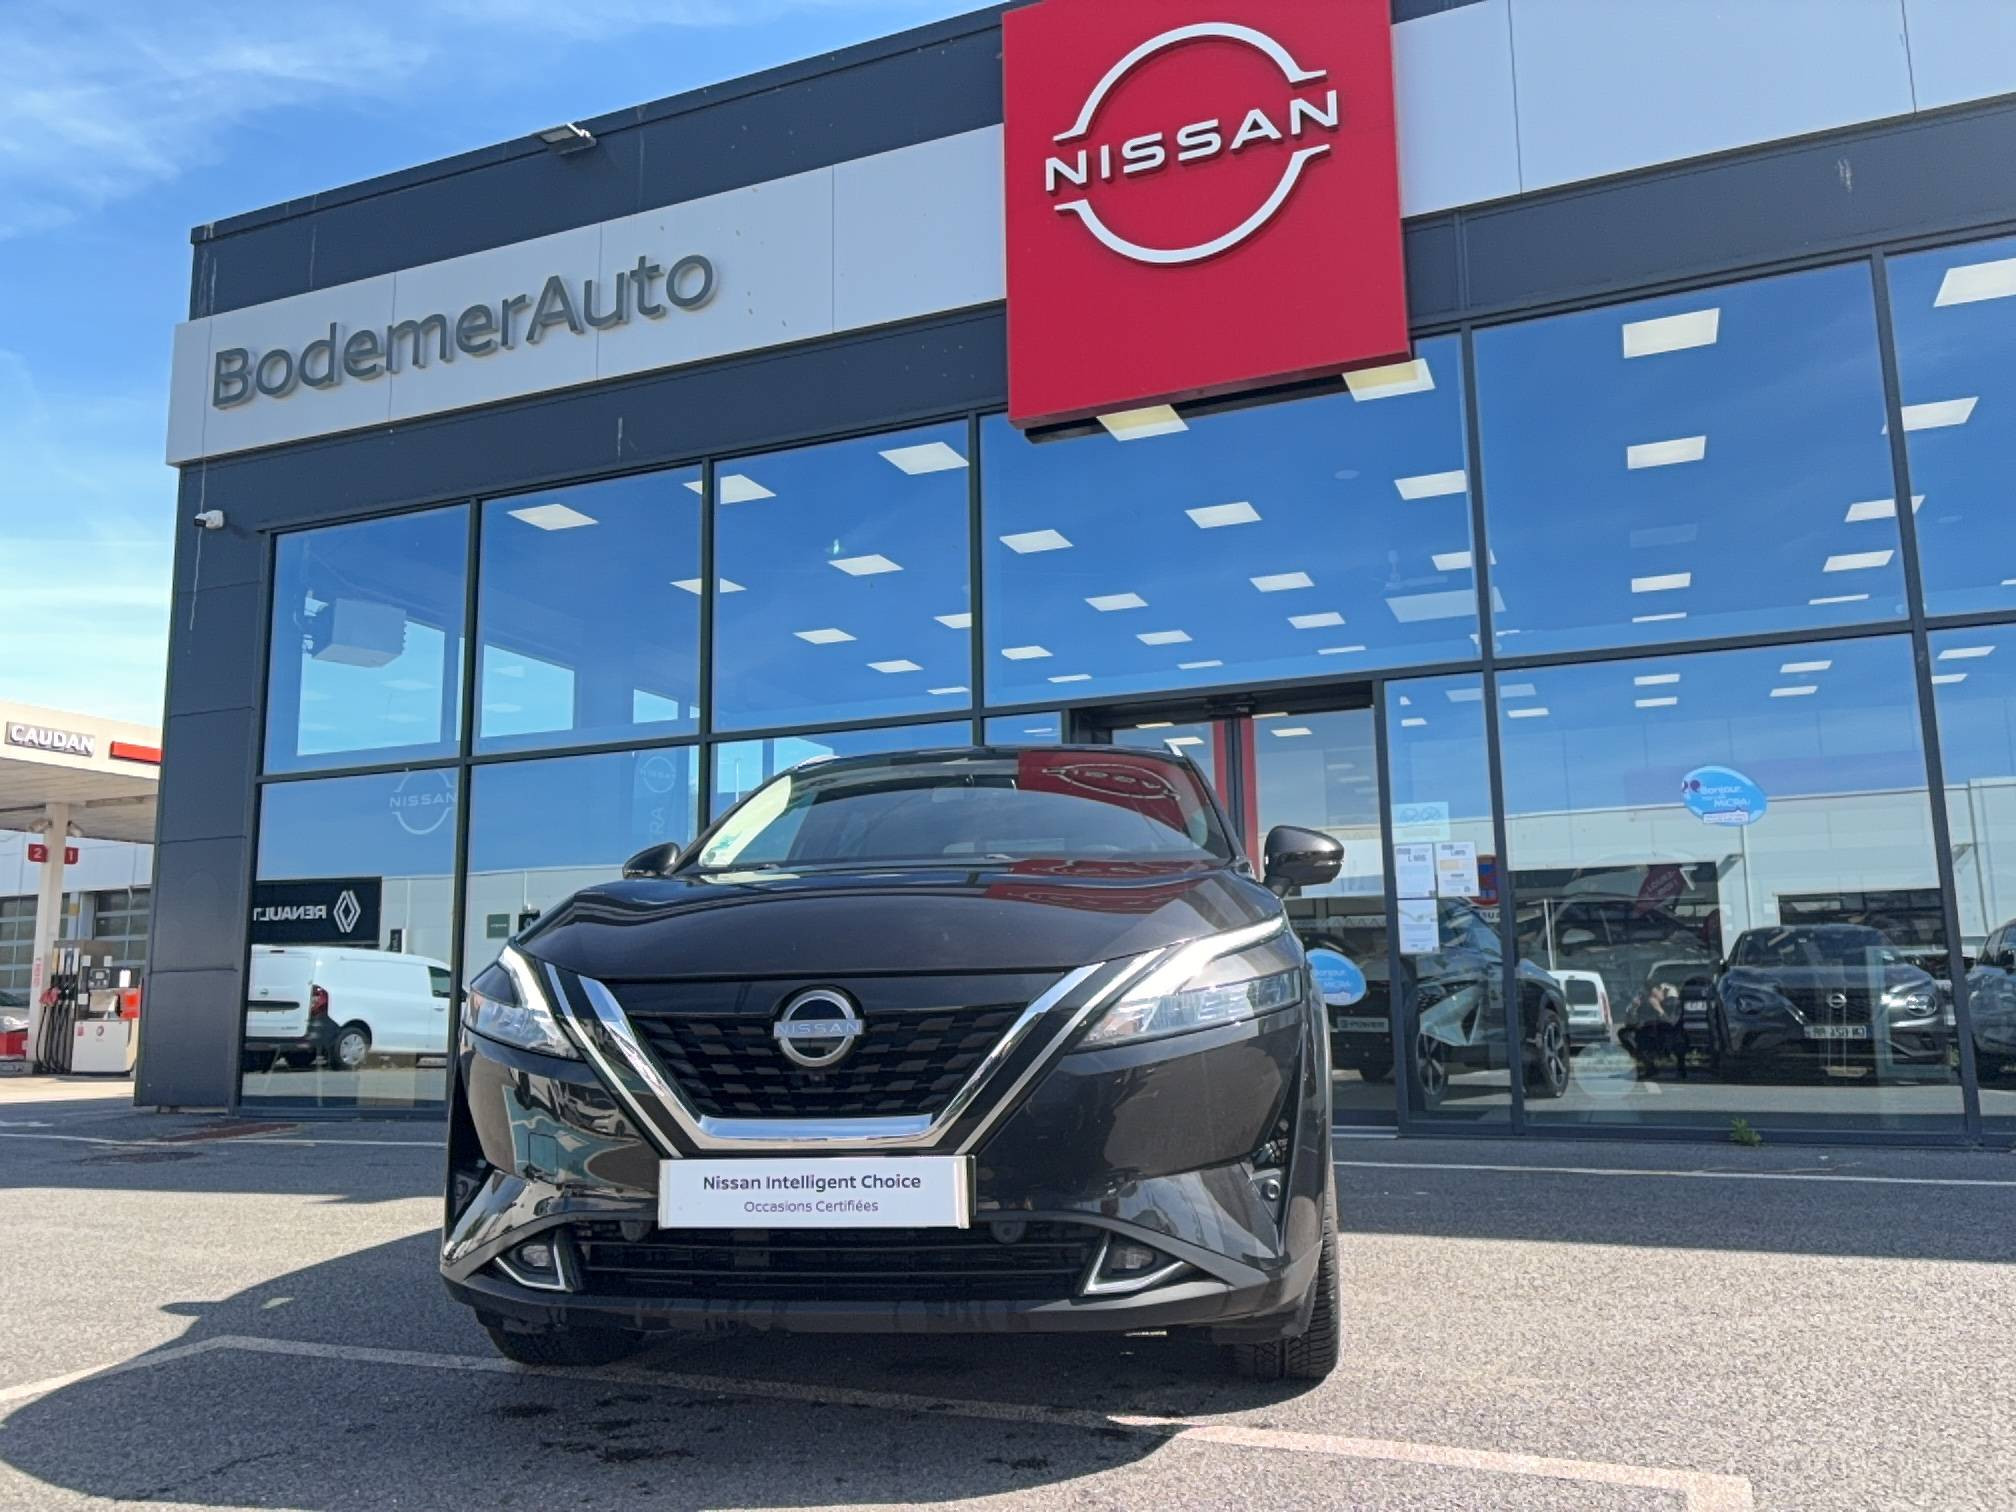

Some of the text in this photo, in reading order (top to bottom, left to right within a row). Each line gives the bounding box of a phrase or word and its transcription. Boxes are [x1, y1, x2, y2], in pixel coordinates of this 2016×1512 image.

[1045, 89, 1338, 192] NISSAN
[212, 253, 716, 408] BodemerAuto
[10, 724, 95, 755] CAUDAN
[389, 791, 459, 808] NISSAN
[33, 848, 42, 859] 2
[775, 1020, 861, 1036] NISSAN
[703, 1173, 922, 1192] Nissan Intelligent Choice
[744, 1198, 879, 1213] Occasions Certifiées
